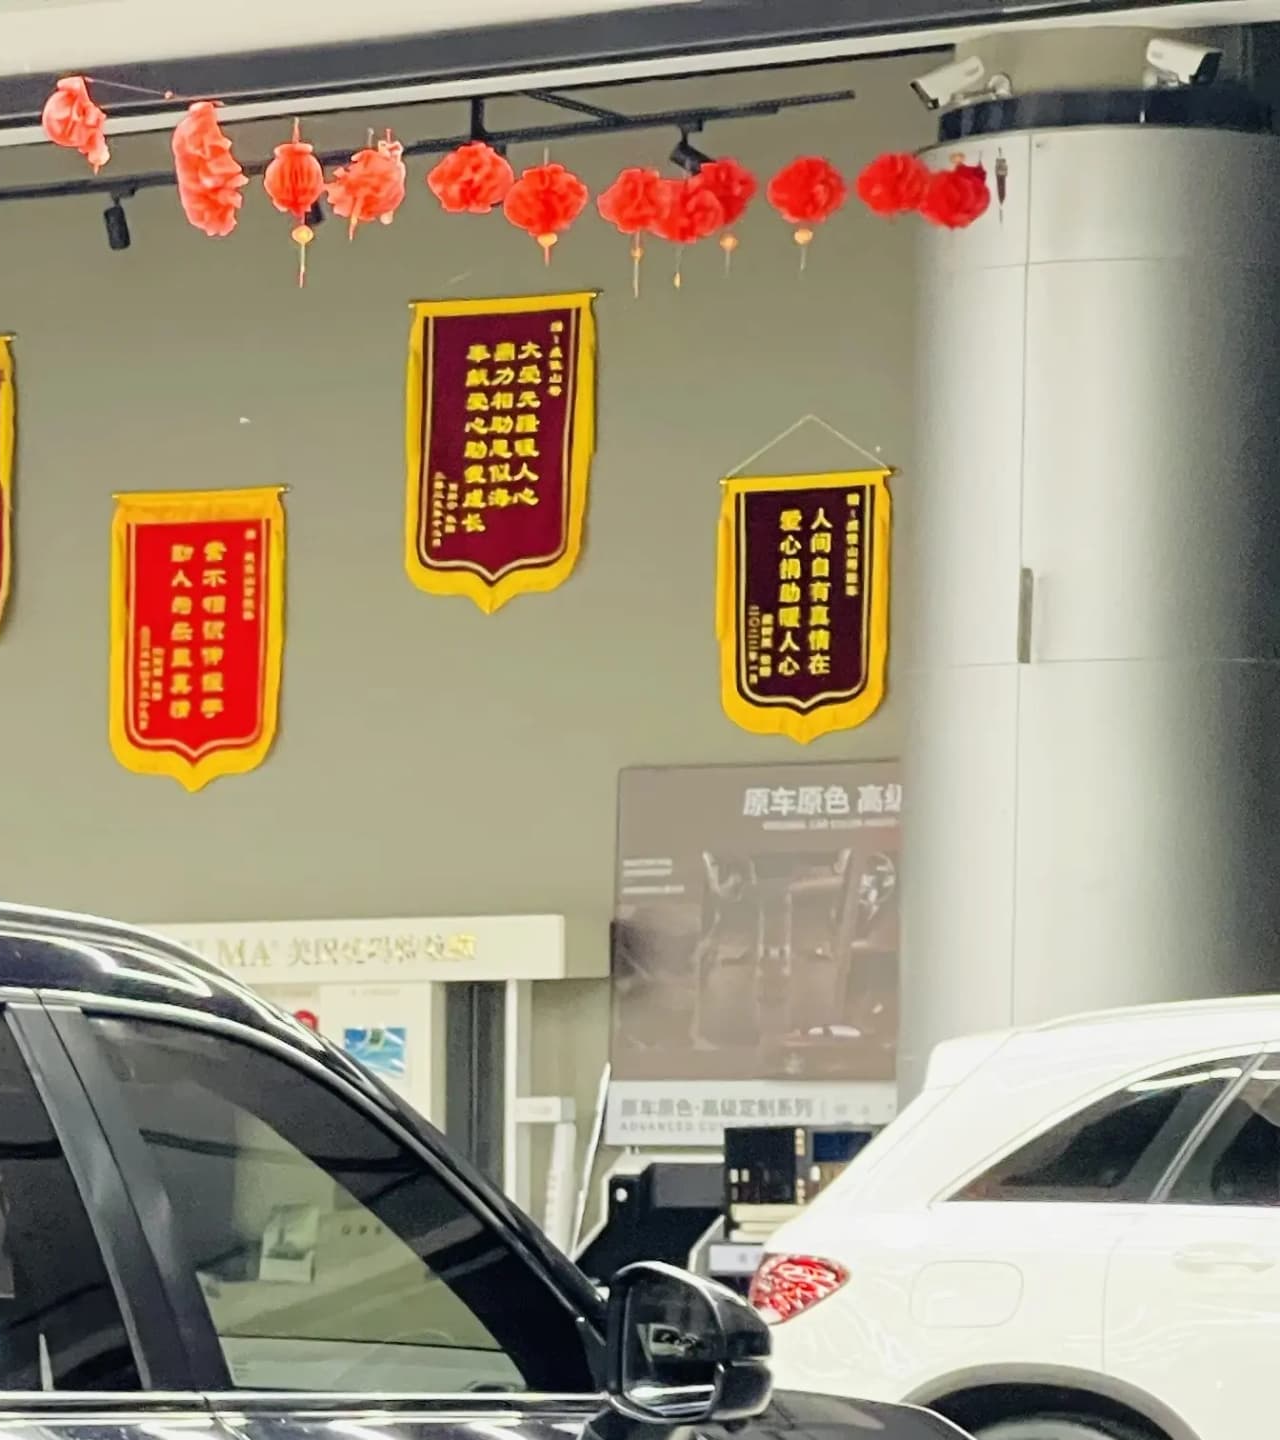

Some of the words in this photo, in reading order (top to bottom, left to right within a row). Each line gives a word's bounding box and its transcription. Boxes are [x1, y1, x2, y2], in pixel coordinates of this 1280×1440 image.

[807, 506, 833, 676] 人间自有真情在
[743, 786, 851, 816] 原车原色
